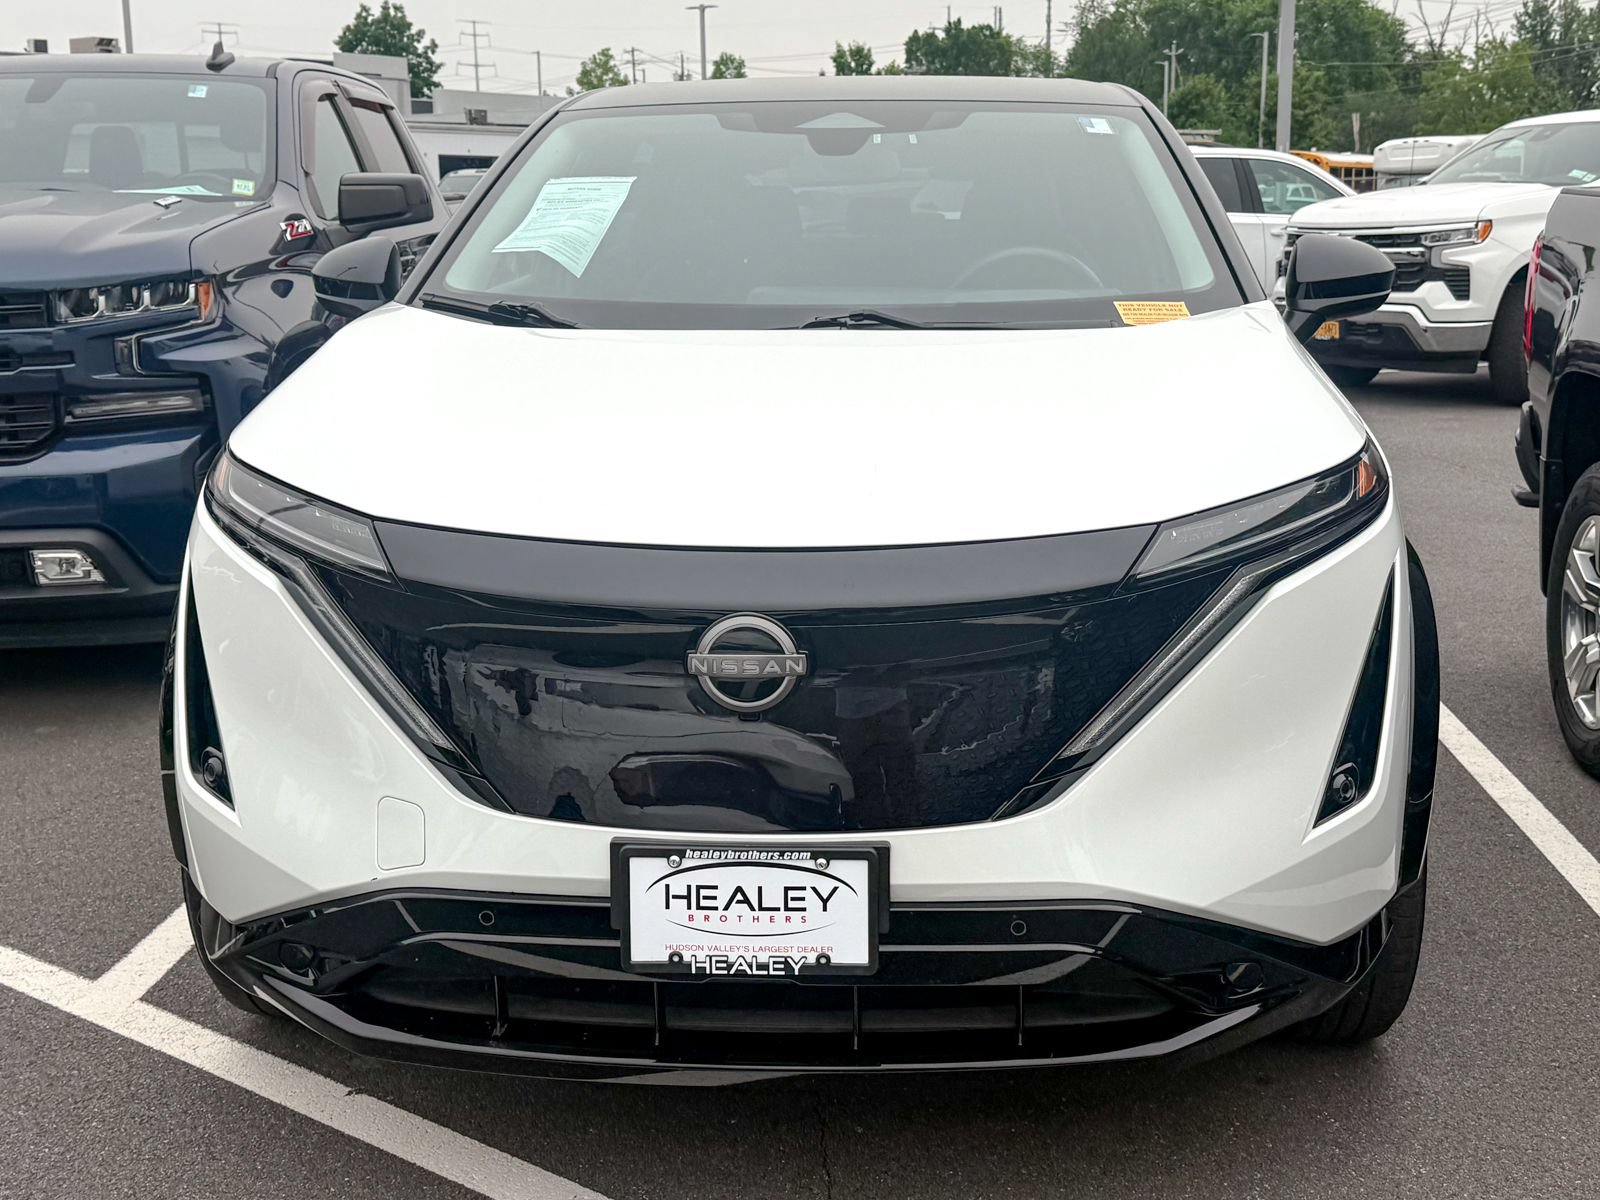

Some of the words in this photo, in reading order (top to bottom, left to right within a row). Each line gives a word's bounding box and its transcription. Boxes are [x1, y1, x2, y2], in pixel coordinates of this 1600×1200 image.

[691, 658, 804, 675] NISSAN
[685, 848, 811, 860] healeybrothers.com
[664, 883, 840, 912] HEALEY
[688, 914, 807, 924] BROTHERS
[665, 943, 704, 952] HUDSON
[707, 944, 750, 953] VALLEY'S
[752, 945, 795, 953] LARGEST
[797, 945, 834, 954] DEALER
[691, 954, 807, 976] HEALEY
